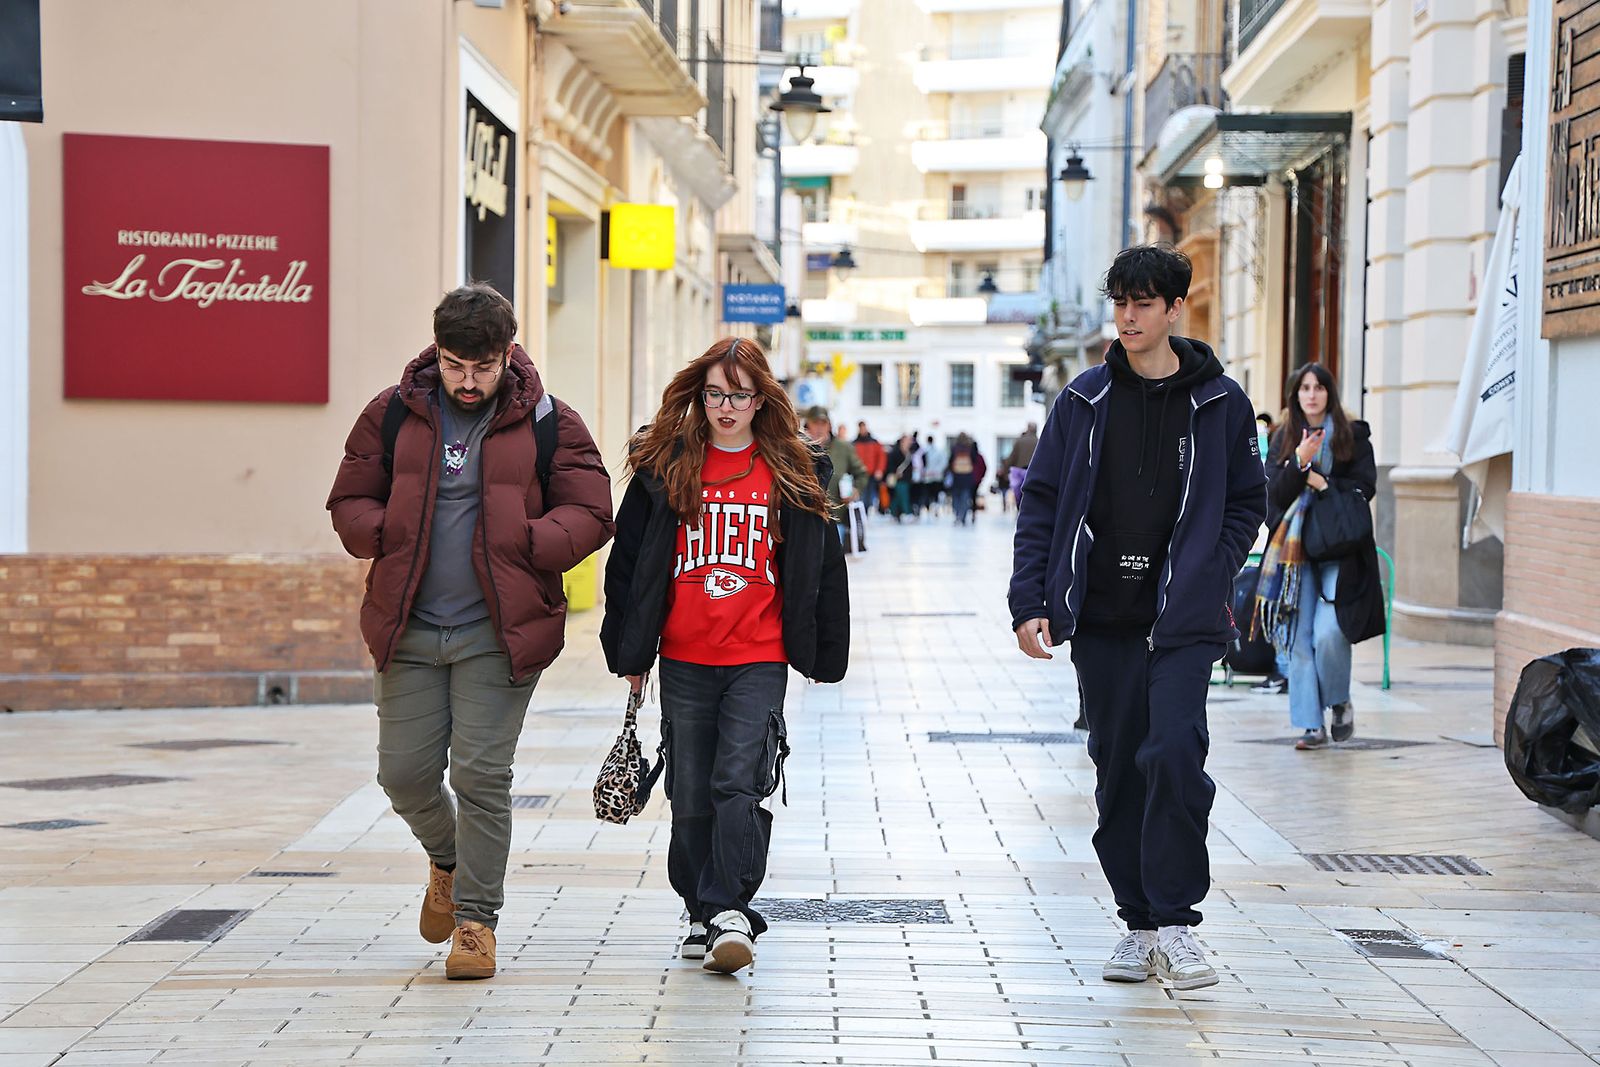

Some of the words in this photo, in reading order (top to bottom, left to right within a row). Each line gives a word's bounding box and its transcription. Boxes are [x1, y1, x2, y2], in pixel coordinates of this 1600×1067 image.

[117, 229, 207, 248] RISTORANTI
[216, 233, 279, 251] PIZZERIE
[81, 253, 148, 300] La
[149, 257, 313, 308] Tagliatella
[702, 490, 735, 499] SAS
[751, 491, 767, 500] CI
